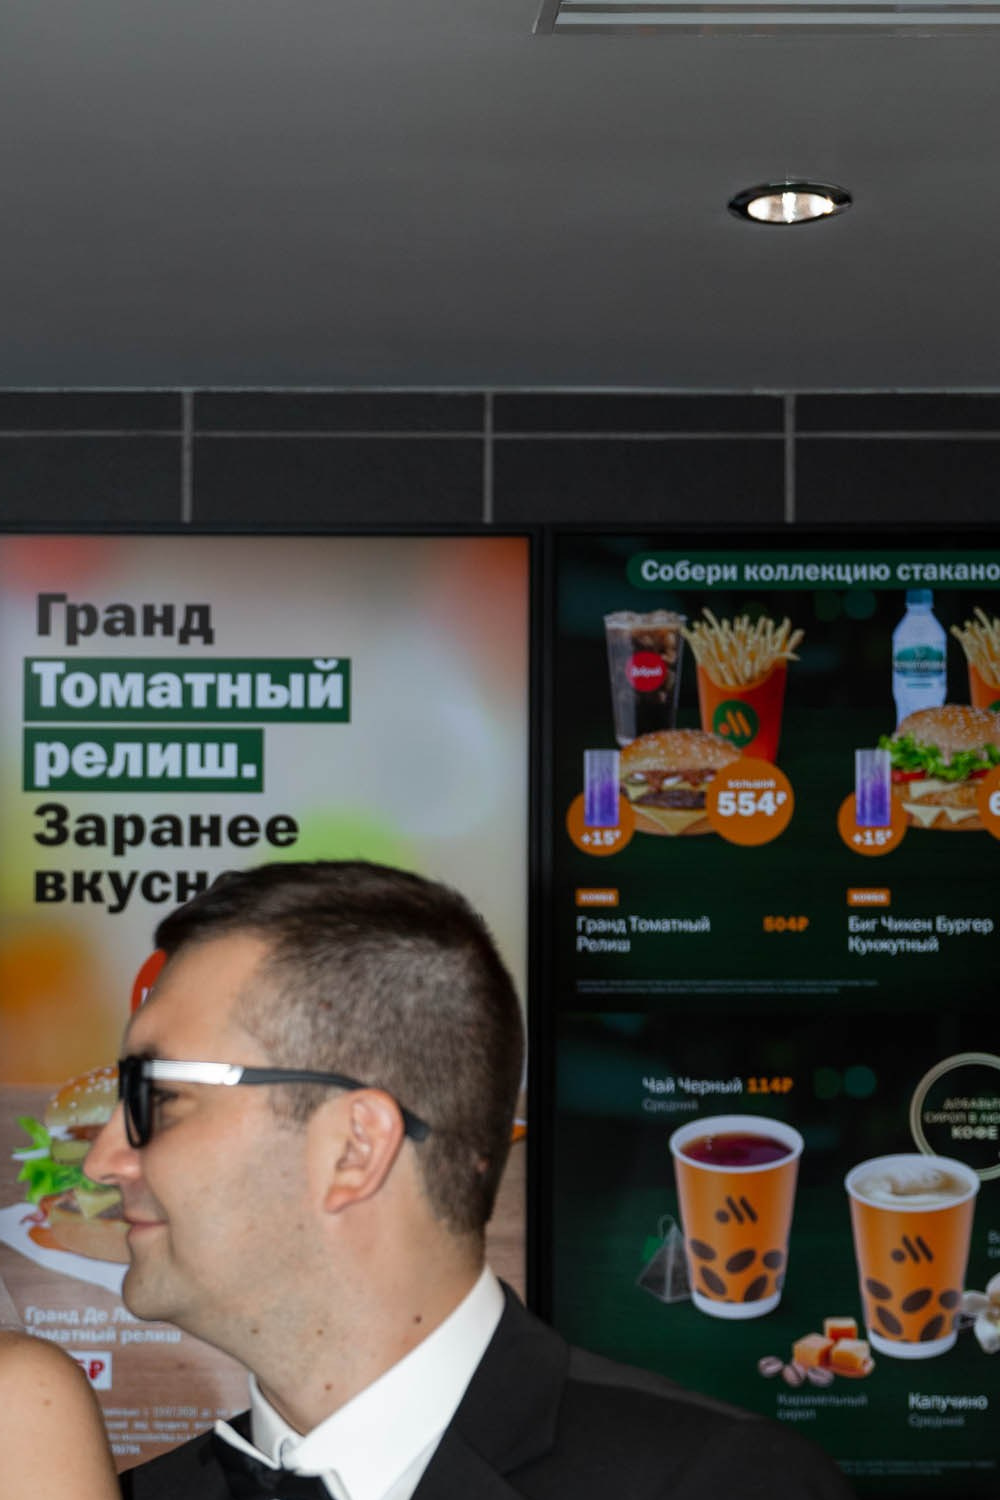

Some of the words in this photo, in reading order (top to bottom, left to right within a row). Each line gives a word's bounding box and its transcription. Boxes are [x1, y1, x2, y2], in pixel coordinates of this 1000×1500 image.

[641, 559, 738, 585] Собери
[743, 562, 890, 585] коллекцию
[36, 593, 215, 646] Гранд
[32, 659, 344, 710] Томатный
[33, 740, 257, 788] релиш.
[33, 803, 299, 856] Заранее
[34, 870, 220, 914] вкусн
[576, 916, 627, 934] Гранд
[629, 916, 711, 933] Томатный
[849, 915, 879, 932] Биг
[881, 915, 933, 932] Чикен
[935, 915, 994, 935] Бургер
[642, 1077, 676, 1094] Чай
[678, 1077, 743, 1095] Черный
[951, 1125, 999, 1140] КОФЕ
[25, 1305, 80, 1326] Гранд
[83, 1305, 108, 1326] Де
[908, 1392, 989, 1412] Капучино
